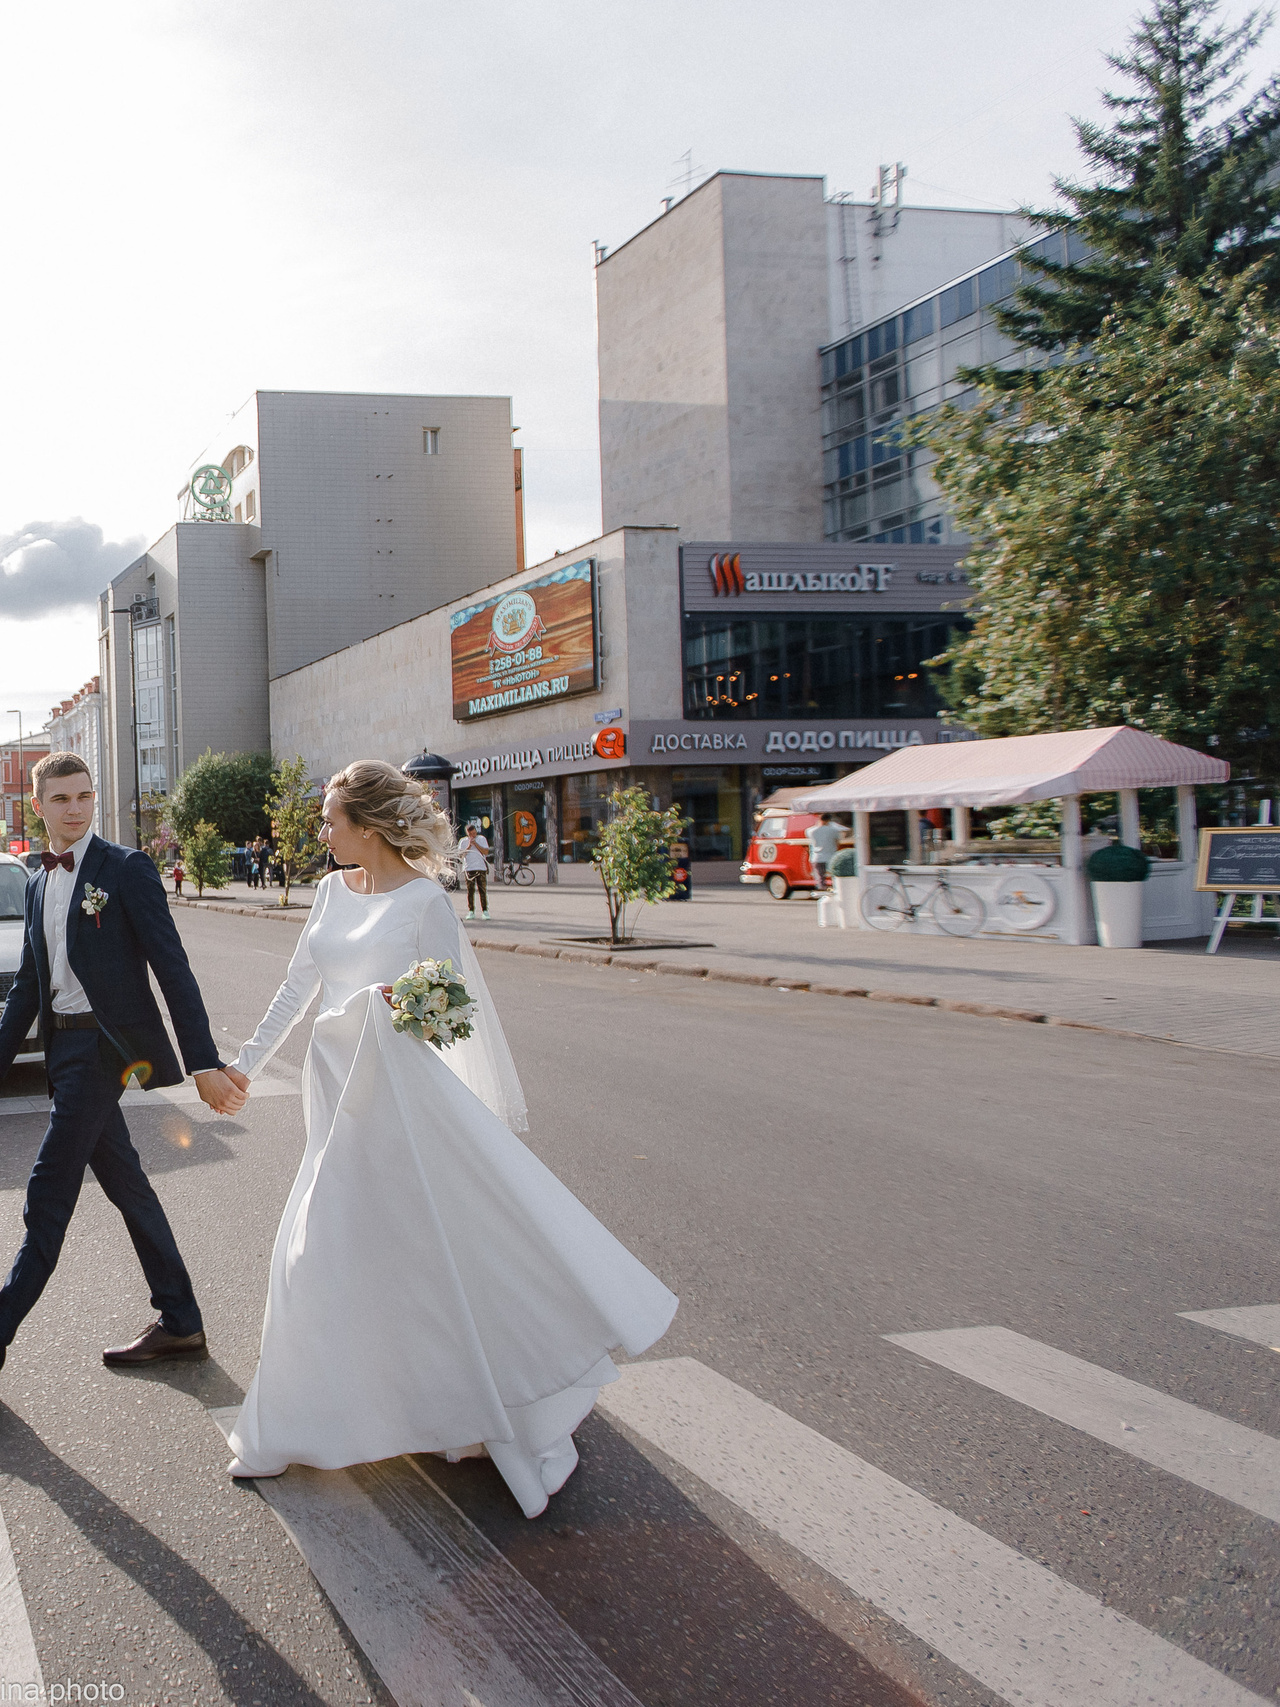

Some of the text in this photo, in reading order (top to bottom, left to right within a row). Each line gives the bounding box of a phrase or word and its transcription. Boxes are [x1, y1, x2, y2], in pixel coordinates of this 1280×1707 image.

[468, 675, 570, 715] MAXIMILIANS.RU
[651, 733, 748, 753] ДОСТАВКА
[765, 731, 836, 753] ДОДО
[837, 729, 924, 751] ПИЦЦА
[454, 758, 491, 780] ДОДО
[490, 749, 544, 771] ПИЦЦА
[513, 781, 545, 792] DODOPIZZA
[762, 846, 776, 860] 69
